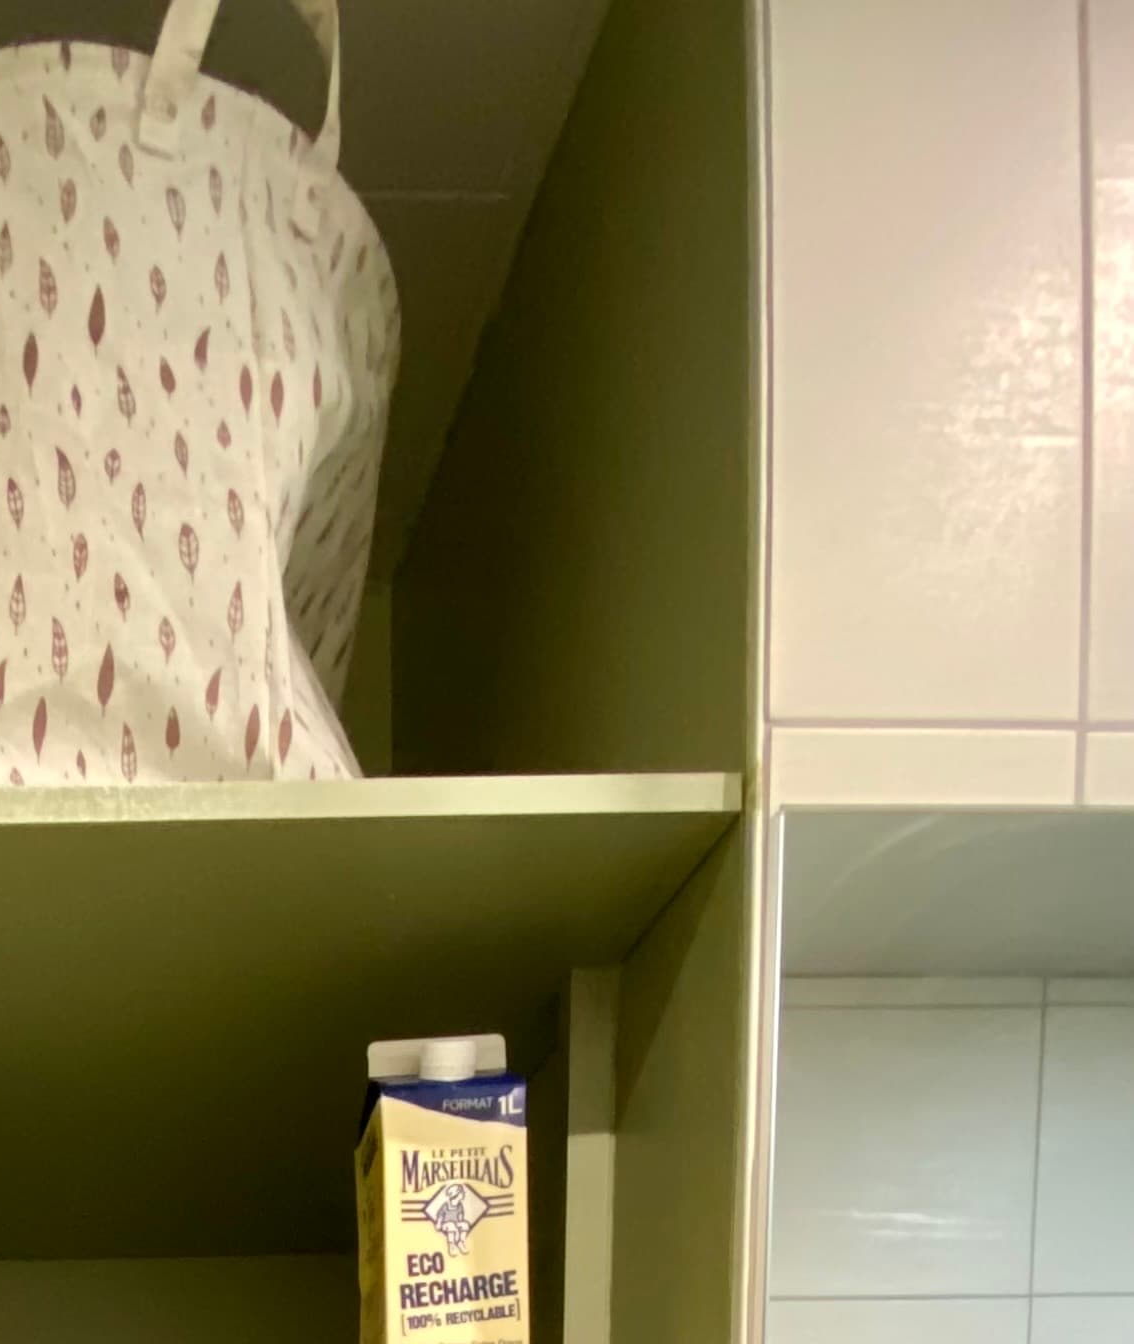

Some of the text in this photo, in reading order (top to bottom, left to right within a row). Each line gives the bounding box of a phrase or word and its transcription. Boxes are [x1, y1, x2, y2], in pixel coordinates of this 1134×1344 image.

[442, 1087, 522, 1115] FORMAT 1L
[432, 1147, 486, 1158] LE PETIT
[401, 1144, 514, 1193] MARSEILLAIS
[407, 1252, 444, 1277] ECO
[400, 1270, 519, 1309] RECHARGE
